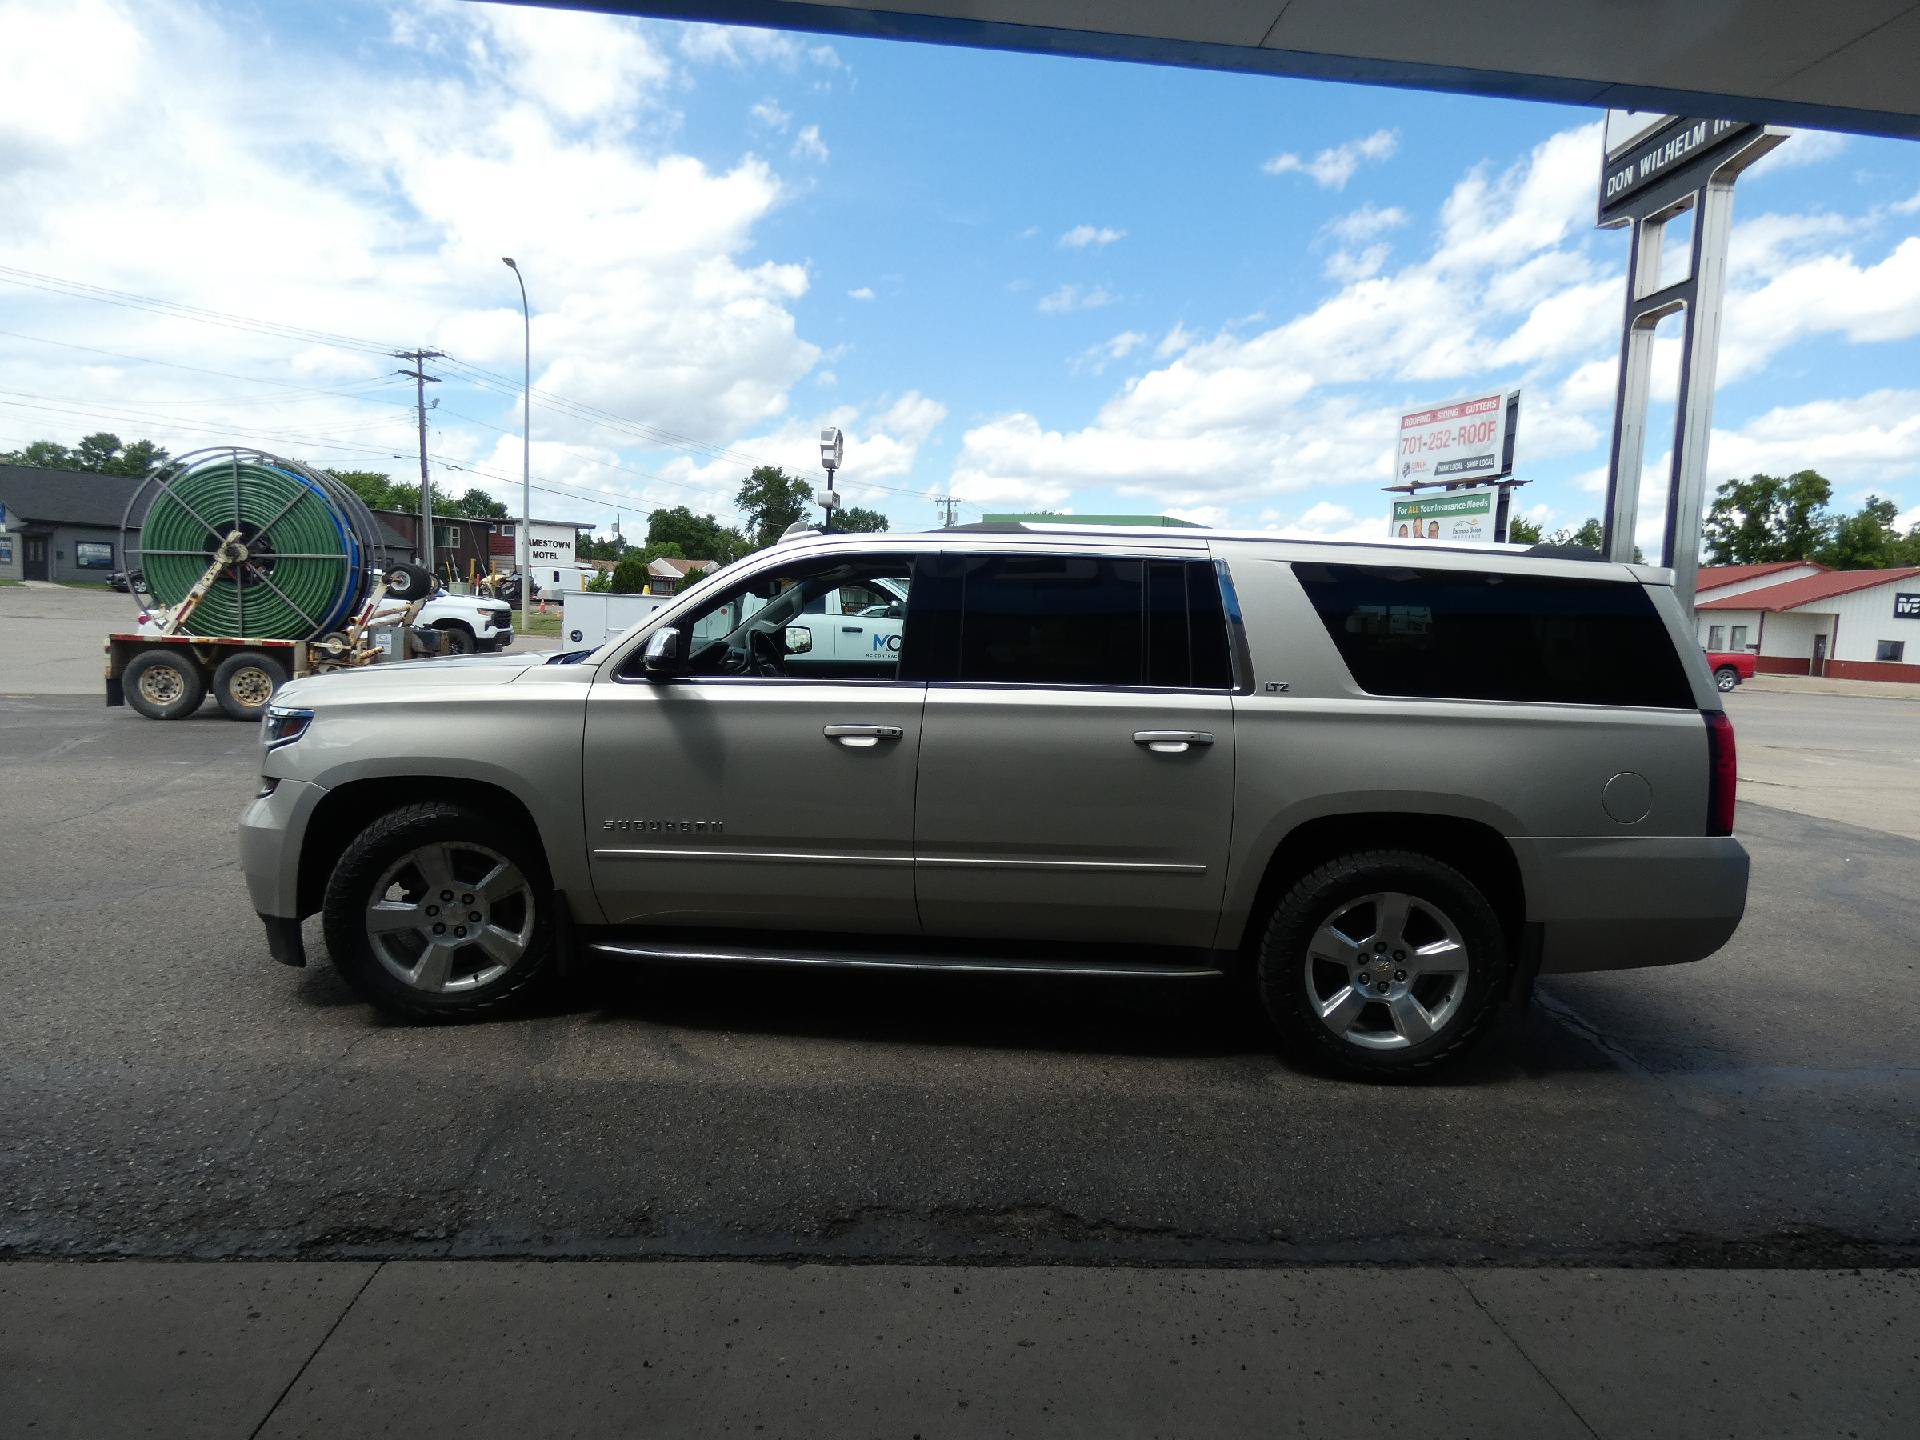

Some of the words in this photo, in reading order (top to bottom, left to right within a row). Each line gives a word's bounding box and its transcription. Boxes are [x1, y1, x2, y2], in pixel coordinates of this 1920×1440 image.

[1606, 165, 1634, 198] DON
[1640, 121, 1707, 178] WILHELM
[1404, 413, 1431, 427] ROOFING
[1438, 407, 1459, 420] SIDING
[1465, 400, 1497, 415] GUTTERS
[1402, 420, 1497, 455] 701-252-ROOF
[1480, 457, 1494, 467] LOCAL
[1397, 506, 1408, 515] For
[1408, 505, 1419, 514] ALL
[1420, 504, 1433, 513] Your
[1467, 498, 1488, 509] Needs
[533, 551, 559, 560] MOTEL
[1265, 681, 1289, 692] LTZ
[603, 819, 724, 832] SUBURBAN
